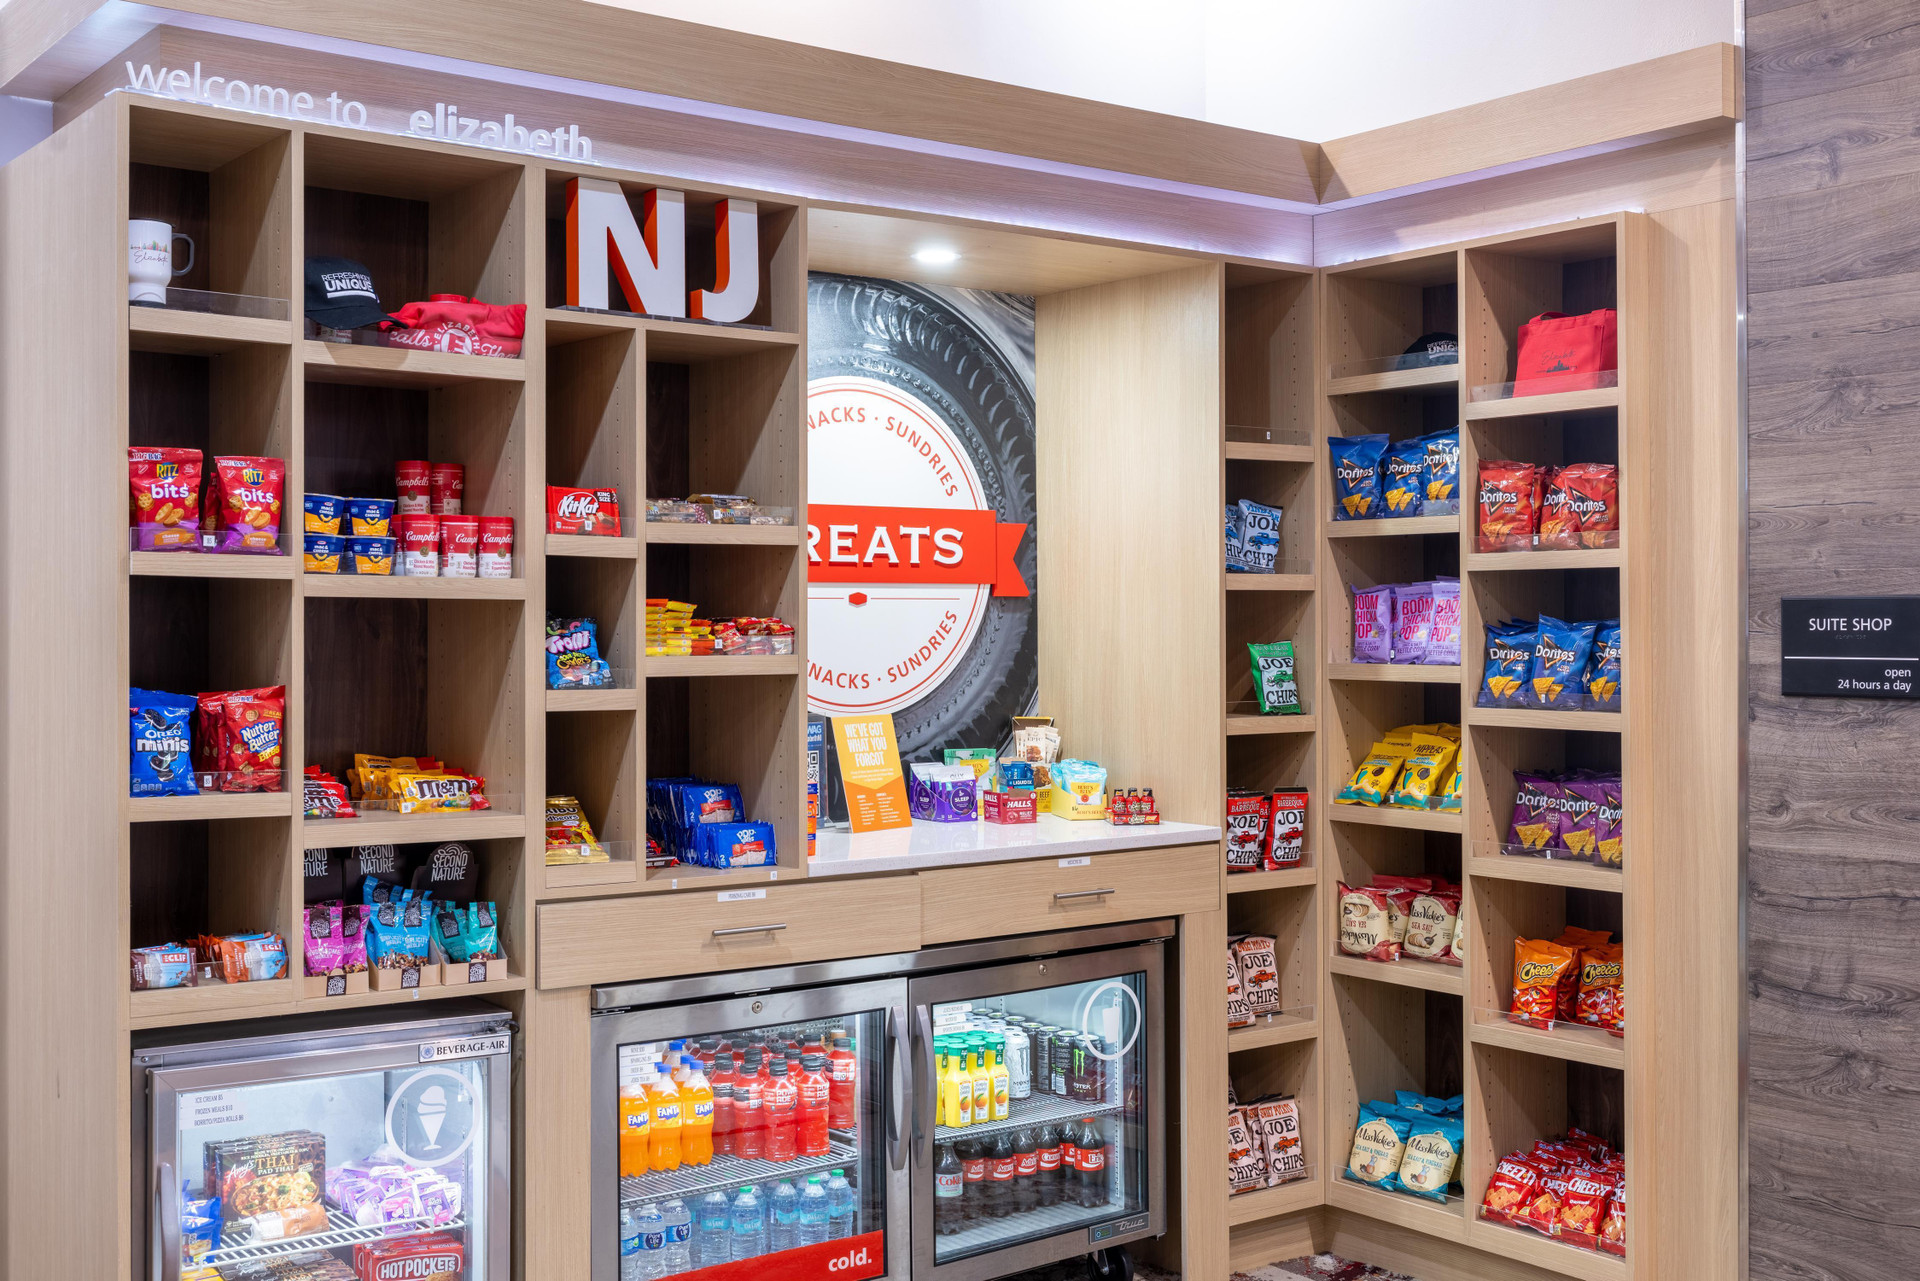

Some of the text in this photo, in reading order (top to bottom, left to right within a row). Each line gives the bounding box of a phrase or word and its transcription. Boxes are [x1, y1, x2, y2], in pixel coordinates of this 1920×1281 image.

[125, 61, 593, 160] welcome to elizabeth
[566, 176, 759, 323] NJ
[885, 416, 959, 497] SUNDRIES
[156, 463, 179, 478] RITZ
[242, 469, 265, 483] RITZ
[1337, 467, 1374, 479] Doritos
[151, 483, 190, 499] bits
[241, 487, 274, 503] bits
[1480, 491, 1517, 503] Doritos
[559, 496, 599, 518] KitKat
[1402, 598, 1434, 615] BOOM
[1809, 618, 1892, 631] SUITE SHOP
[887, 610, 957, 683] SUNDRIES
[1535, 645, 1575, 661] Doritos
[1262, 657, 1293, 670] JOE
[1884, 669, 1911, 679] open
[1838, 679, 1912, 693] 24 hours a day
[1266, 689, 1298, 705] CHIPS
[242, 721, 276, 741] Nutter
[844, 722, 884, 738] WE'VE GOT
[136, 737, 190, 752] minis
[248, 729, 280, 752] Butter
[847, 736, 887, 753] WHAT YOU
[854, 751, 885, 768] FORGOT
[1006, 800, 1033, 808] HALLS
[360, 858, 395, 875] NATURE
[432, 852, 468, 868] SECOND
[431, 866, 466, 882] NATURE
[1244, 953, 1273, 969] JOE
[1247, 987, 1279, 1005] CHIPS
[436, 1040, 506, 1056] BEVERAGE-AIR
[195, 1107, 211, 1115] FROZEN
[1267, 1118, 1296, 1136] JOE
[1356, 1127, 1397, 1150] Miss Vickie's
[1407, 1138, 1452, 1161] Miss Vickie's
[255, 1153, 295, 1170] THAI
[1273, 1153, 1305, 1172] CHIPS
[226, 1159, 256, 1184] Amy's
[258, 1166, 294, 1176] PAD THAI
[938, 1176, 962, 1186] Coke
[828, 1247, 872, 1272] cold.
